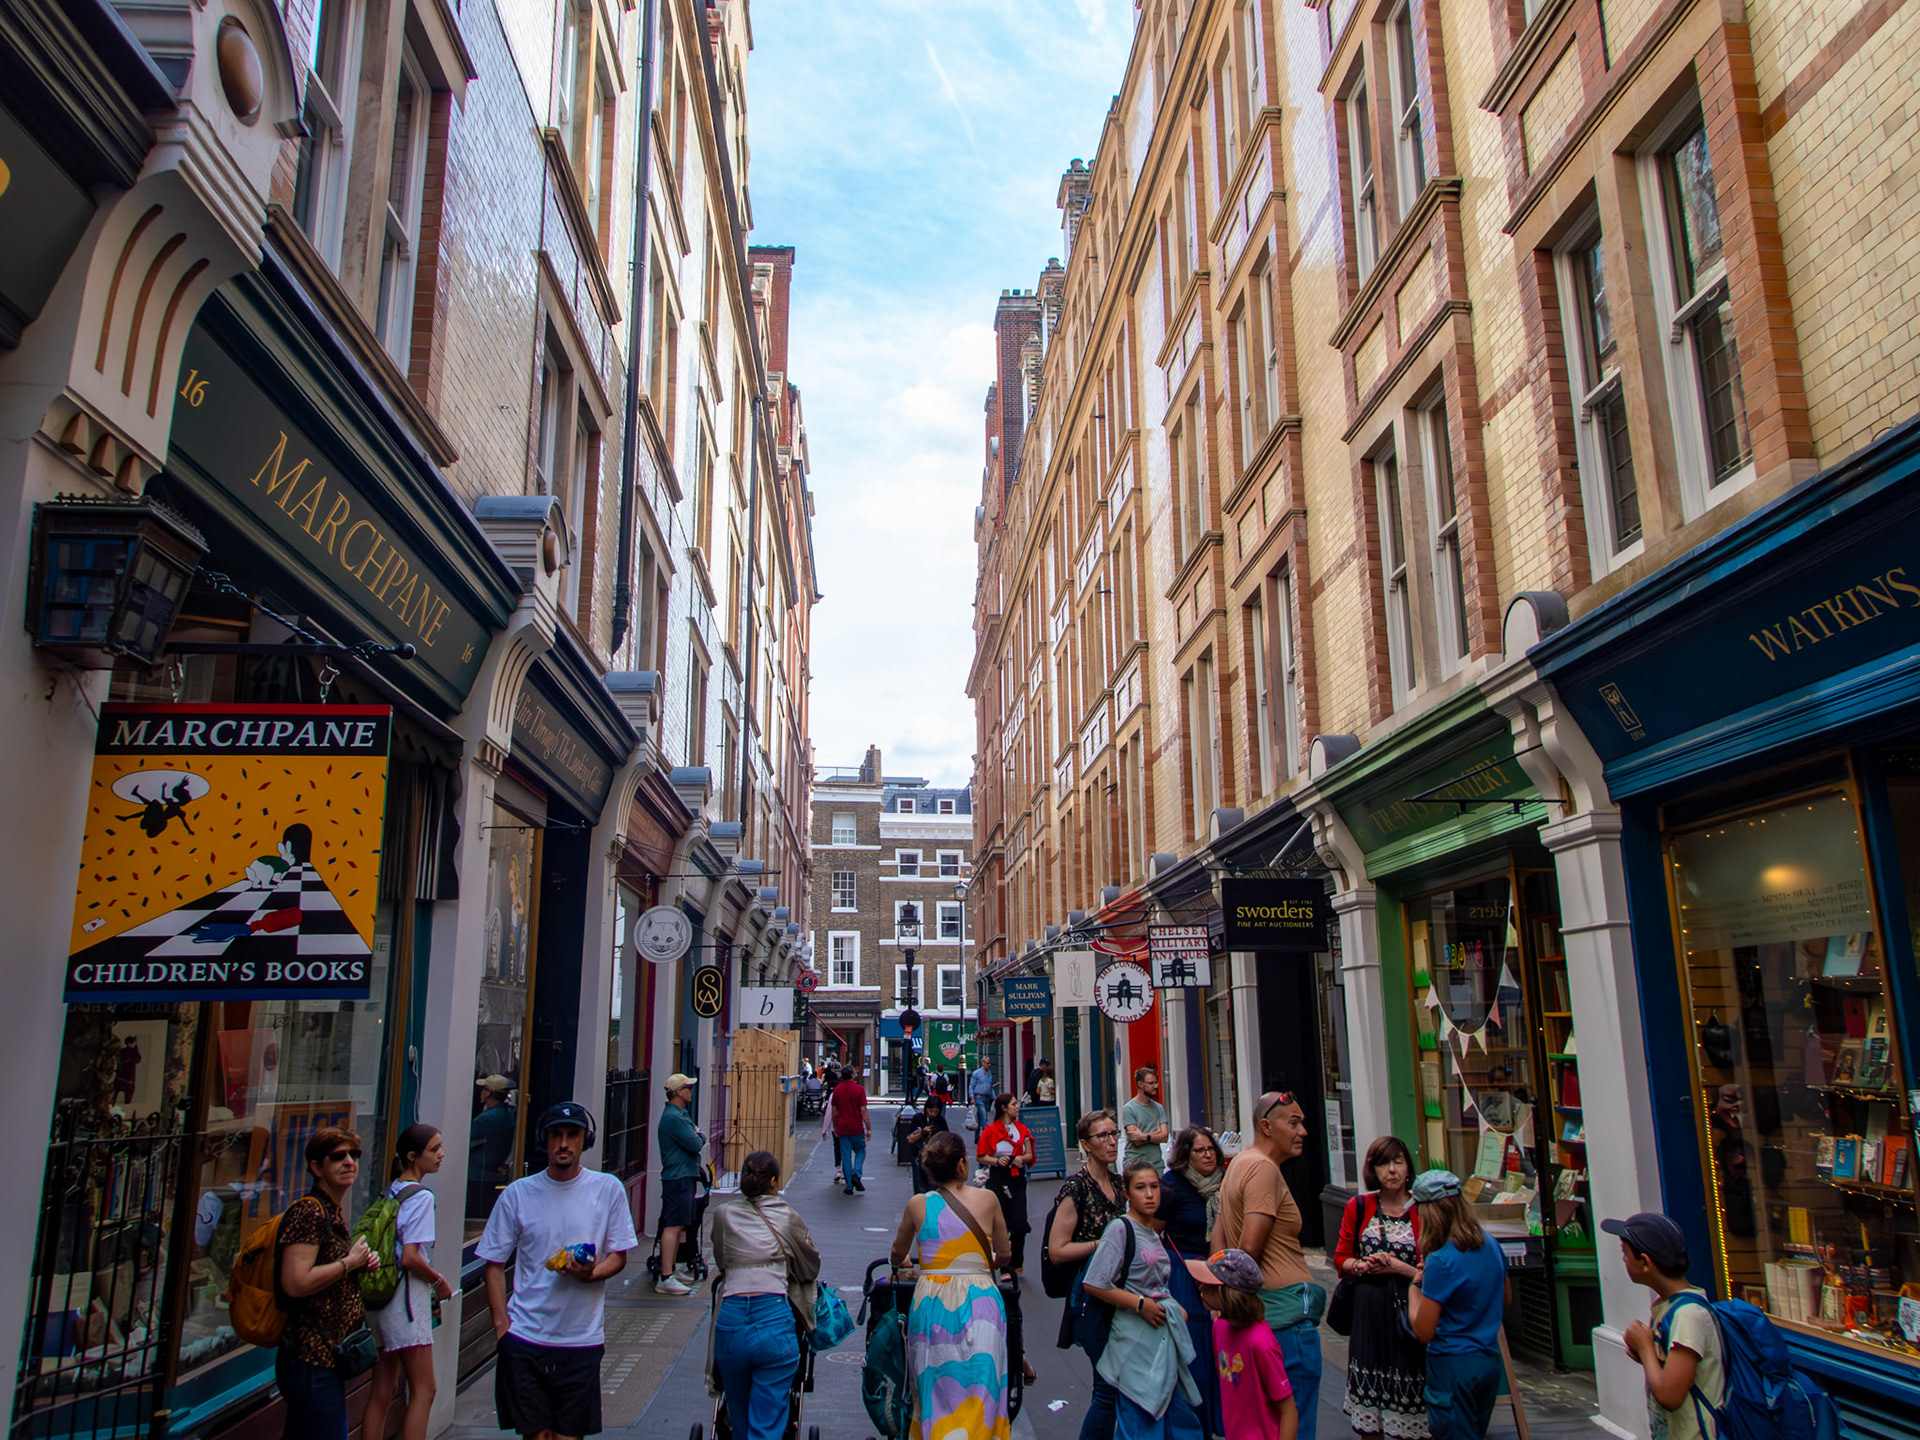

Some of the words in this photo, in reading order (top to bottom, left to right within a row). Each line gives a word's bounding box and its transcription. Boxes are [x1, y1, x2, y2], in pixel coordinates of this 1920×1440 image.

[180, 368, 211, 408] 16
[250, 430, 452, 648] MARCHPANE
[1748, 566, 1920, 662] WATKINS
[460, 642, 474, 664] 16
[109, 719, 377, 748] MARCHPANE
[1236, 900, 1314, 919] sworders
[1150, 925, 1207, 936] CHELSEA
[1269, 921, 1314, 929] AUCTIONEERS
[1151, 938, 1208, 948] MILITARY
[1151, 950, 1209, 961] ANTQUES
[73, 962, 255, 984] CHILDREN'S
[265, 961, 364, 982] BOOKS
[1100, 966, 1112, 980] THE
[1114, 961, 1147, 978] LONDON
[1008, 991, 1046, 1000] SULLIVAN
[1015, 983, 1039, 991] MARK
[759, 994, 775, 1017] b
[1009, 1002, 1047, 1011] ANTIQUES
[1095, 985, 1110, 1015] MEDAL
[1112, 1003, 1153, 1023] COMPANY
